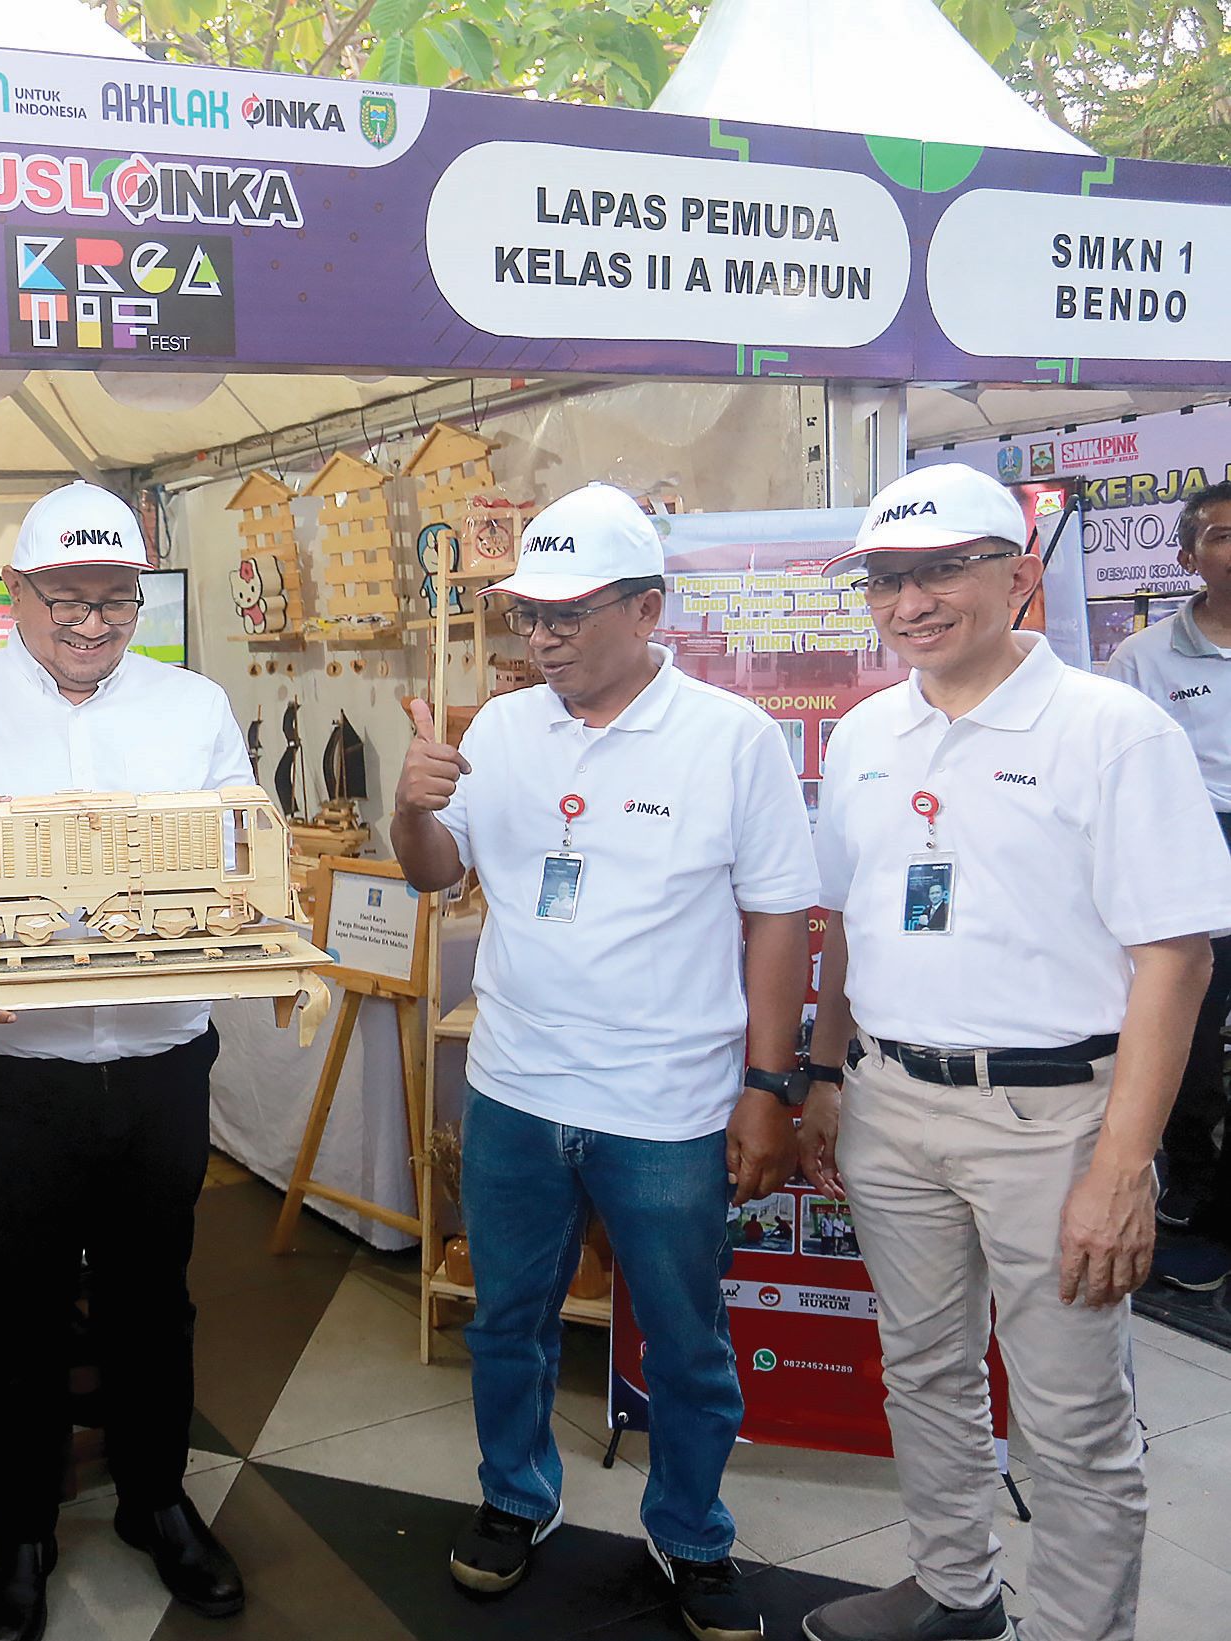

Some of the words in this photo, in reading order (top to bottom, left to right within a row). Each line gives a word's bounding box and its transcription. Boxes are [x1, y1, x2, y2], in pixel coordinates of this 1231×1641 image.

[14, 87, 61, 102] UNTUK
[15, 103, 87, 119] INDONESIA
[101, 81, 229, 129] AKHLAK
[266, 98, 346, 132] INKA
[537, 186, 667, 231] LAPAS
[681, 197, 840, 242] PEMUDA
[1051, 233, 1163, 273] SMKN
[1179, 241, 1192, 274] 1
[495, 246, 632, 288] KELAS
[647, 255, 671, 290] II
[685, 257, 712, 293] A
[725, 259, 871, 300] MADIUN
[1055, 285, 1187, 323] BENDO
[150, 335, 190, 351] FEST
[1083, 467, 1208, 511] KERJA
[881, 501, 937, 524] INKA
[76, 529, 123, 548] INKA
[1083, 513, 1181, 554] ONO
[530, 536, 575, 553] INKA
[1097, 566, 1147, 582] DESAIN
[1149, 562, 1200, 579] KOM
[676, 576, 741, 594] Program
[685, 596, 727, 615] Lapas
[731, 594, 793, 611] Pemuda
[796, 594, 839, 609] Kelas
[825, 613, 873, 632] denga
[755, 635, 791, 650] INKA
[1178, 684, 1211, 700] INKA
[747, 695, 837, 710] ROPONIK
[1003, 773, 1036, 786] INKA
[637, 802, 670, 817] INKA
[721, 1287, 738, 1297] LAK
[798, 1292, 851, 1302] REFORMASI
[799, 1298, 850, 1311] HUKUM
